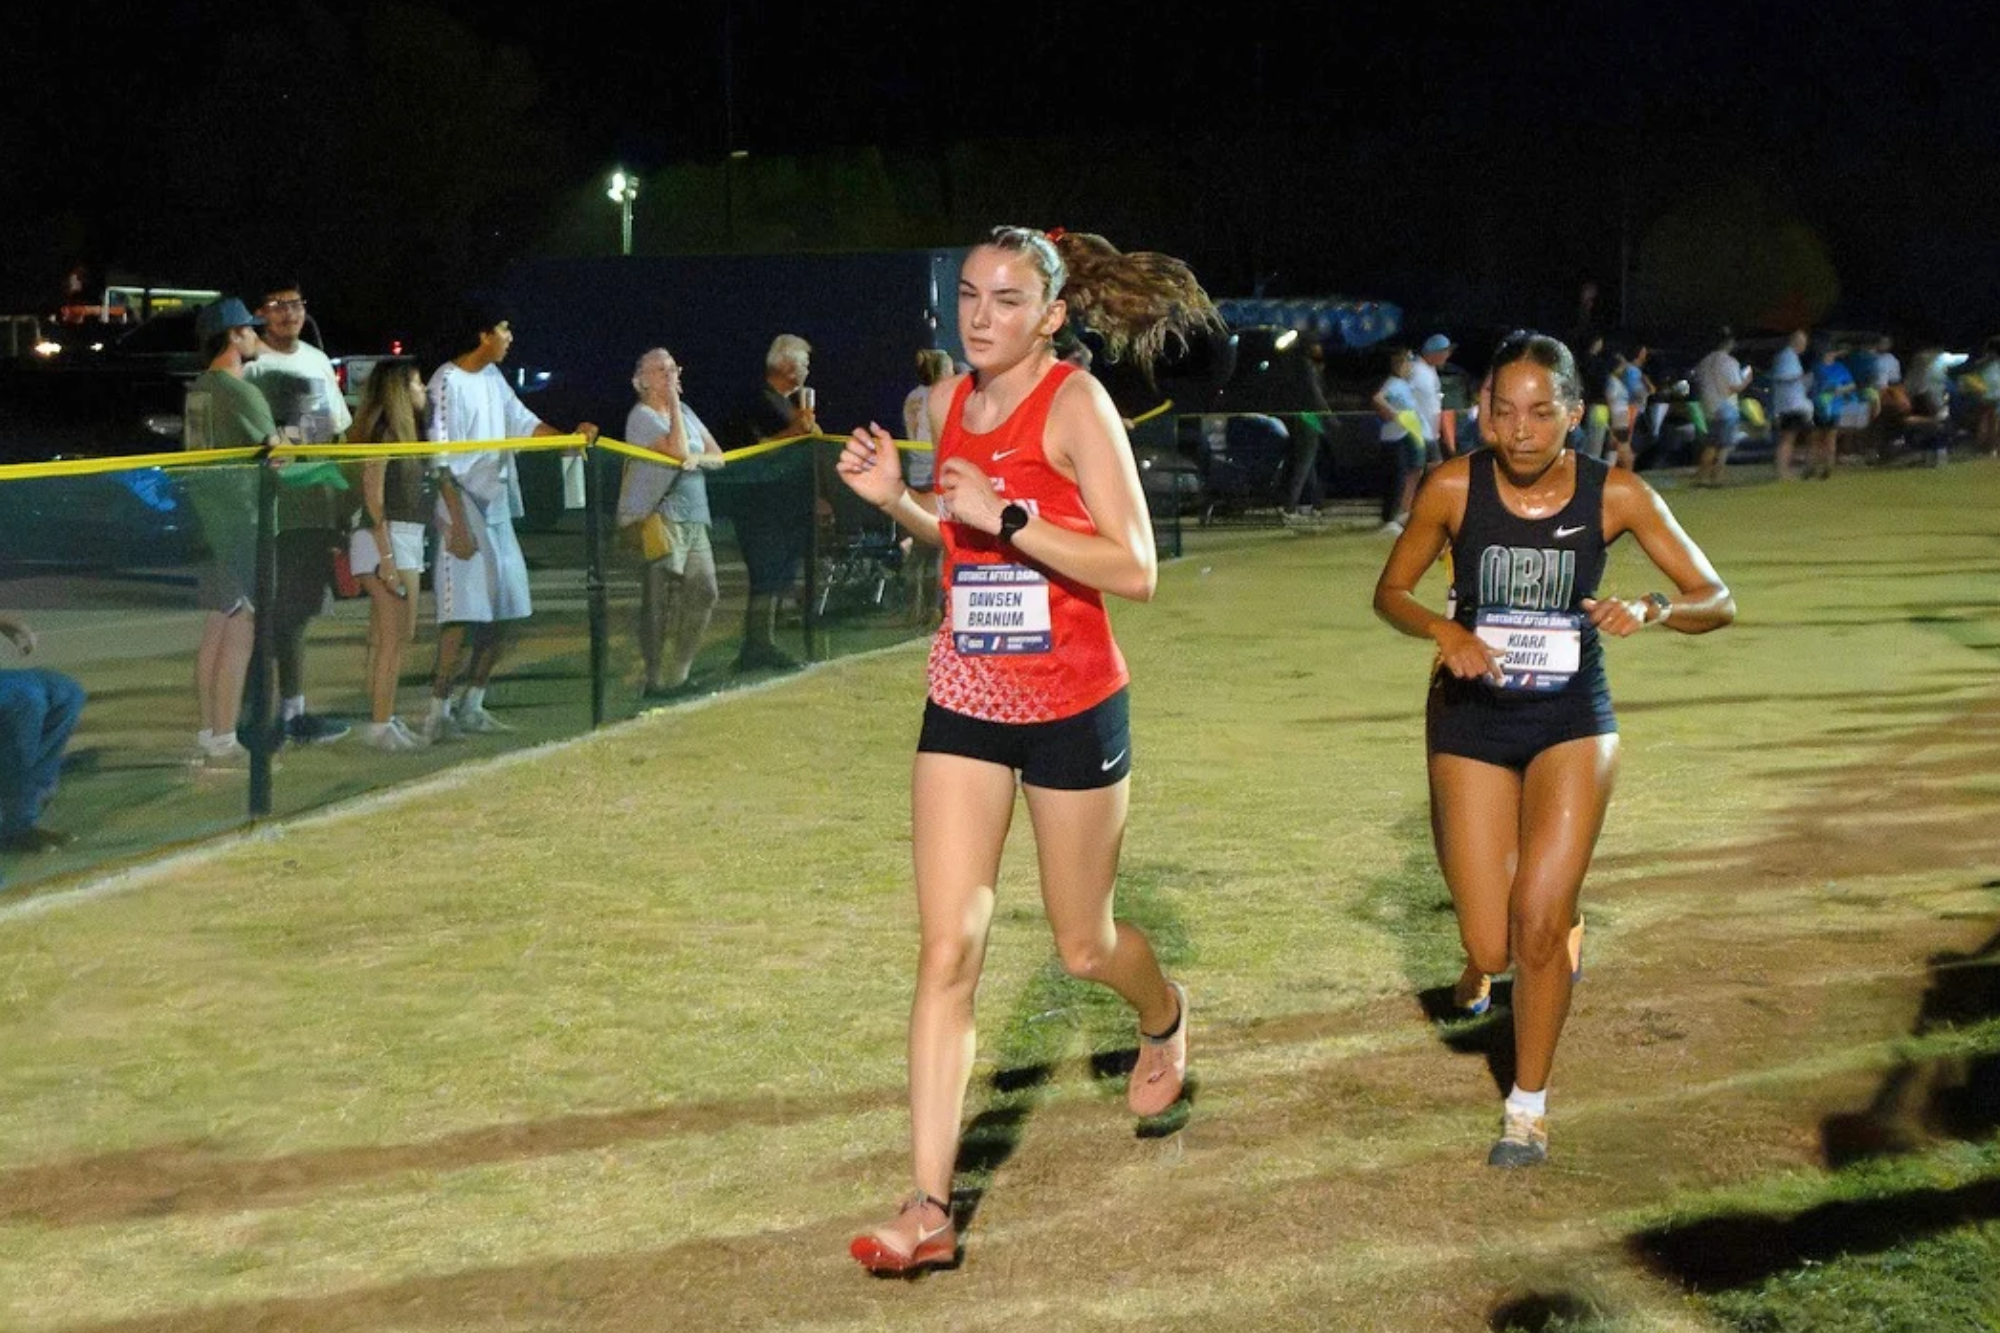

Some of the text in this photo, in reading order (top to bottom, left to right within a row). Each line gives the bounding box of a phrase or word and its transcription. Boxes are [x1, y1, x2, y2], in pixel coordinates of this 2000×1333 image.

[1481, 545, 1576, 609] OBU
[969, 592, 1022, 606] DAWSEN
[968, 611, 1024, 626] BRANUM
[1507, 633, 1546, 647] KIARA
[1504, 651, 1548, 666] SMITH
